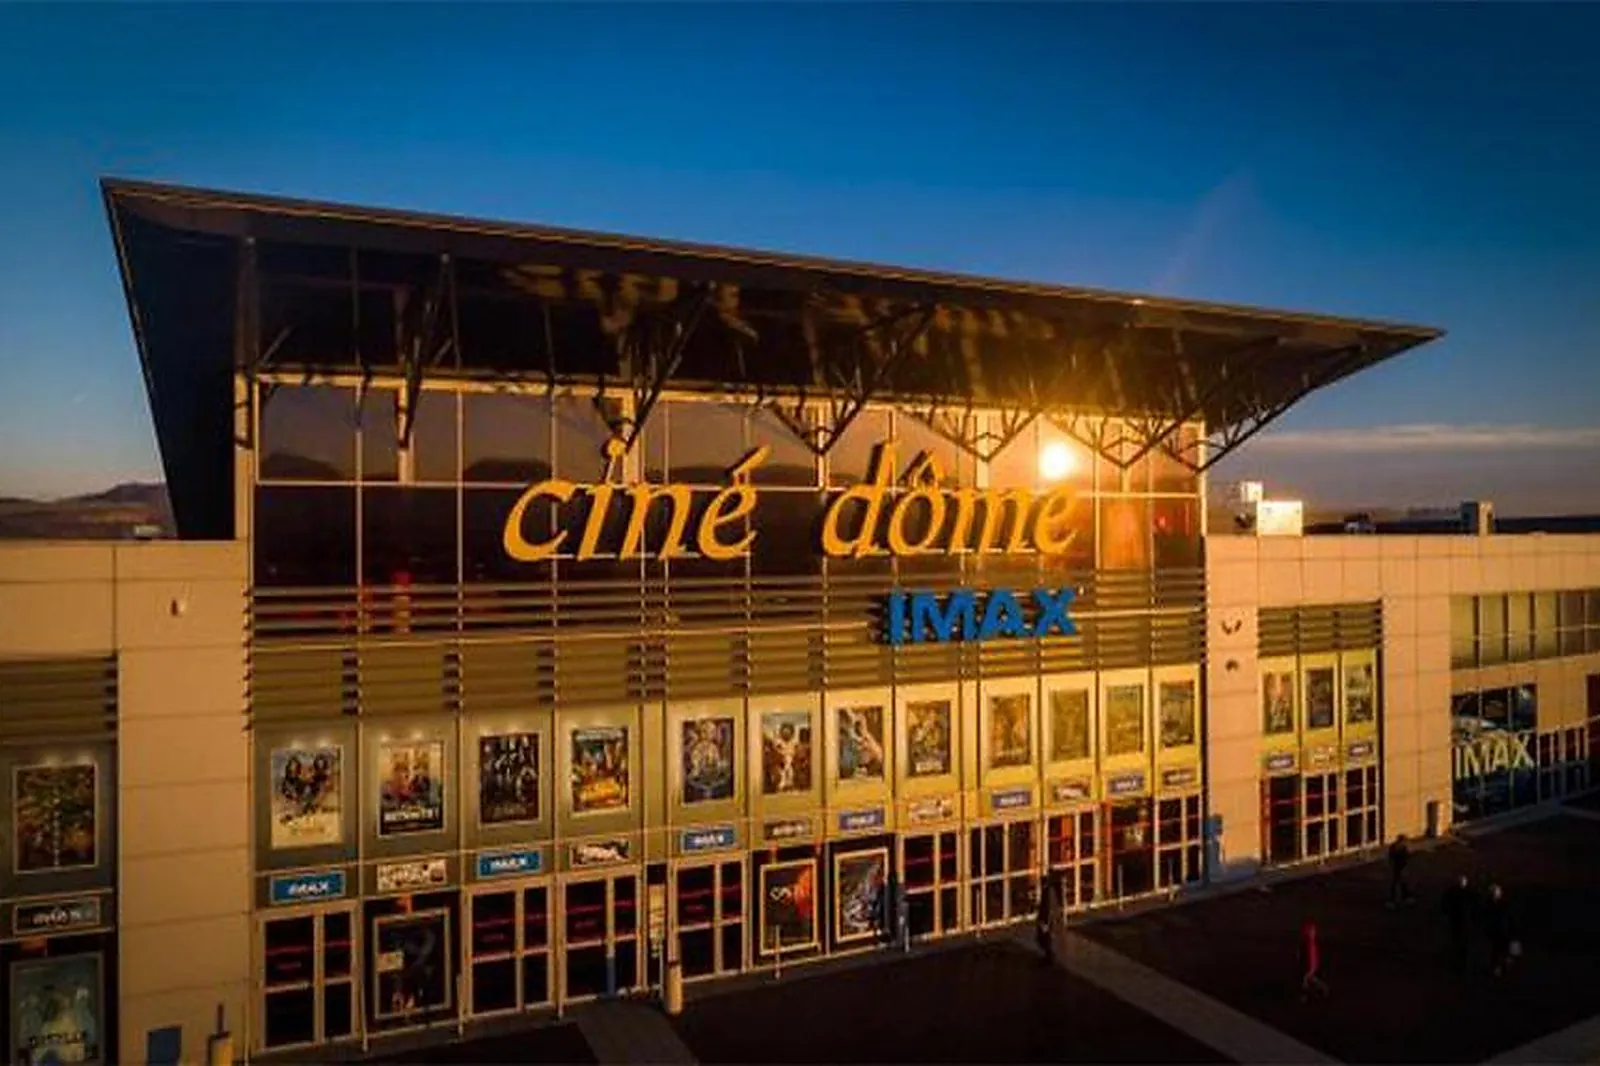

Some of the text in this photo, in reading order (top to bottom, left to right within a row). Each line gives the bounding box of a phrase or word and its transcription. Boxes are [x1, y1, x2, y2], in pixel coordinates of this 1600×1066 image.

[503, 437, 1080, 562] ciné dôme
[889, 585, 1076, 647] IMAX
[1456, 733, 1535, 780] IMAX
